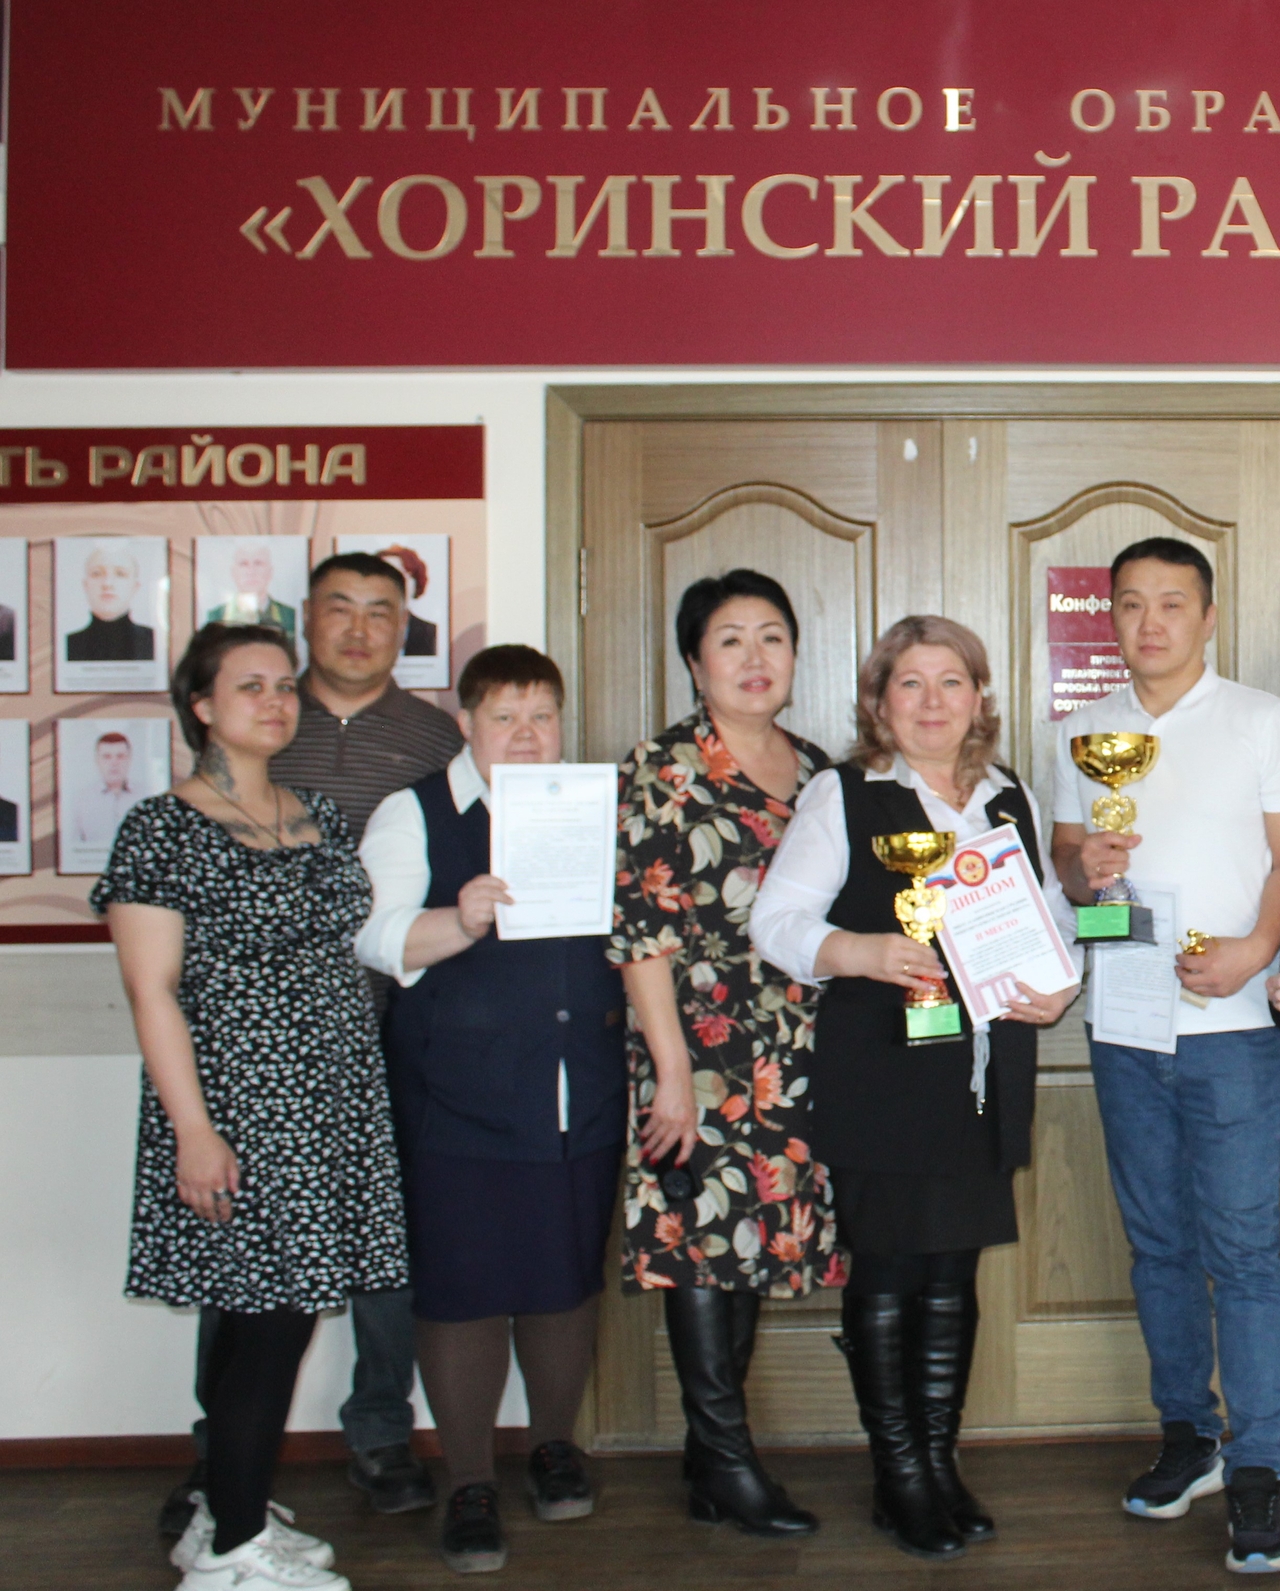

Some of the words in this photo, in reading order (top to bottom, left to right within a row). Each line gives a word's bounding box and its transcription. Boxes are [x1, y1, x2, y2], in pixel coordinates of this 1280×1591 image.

[157, 87, 977, 141] МУНИЦИПАЛЬНОЕ
[239, 150, 1097, 260] «ХОРИНСКИЙ
[89, 434, 366, 486] РАЙОНА
[951, 876, 1016, 914] ДИПЛОМ
[985, 918, 1019, 939] МЕСТО
